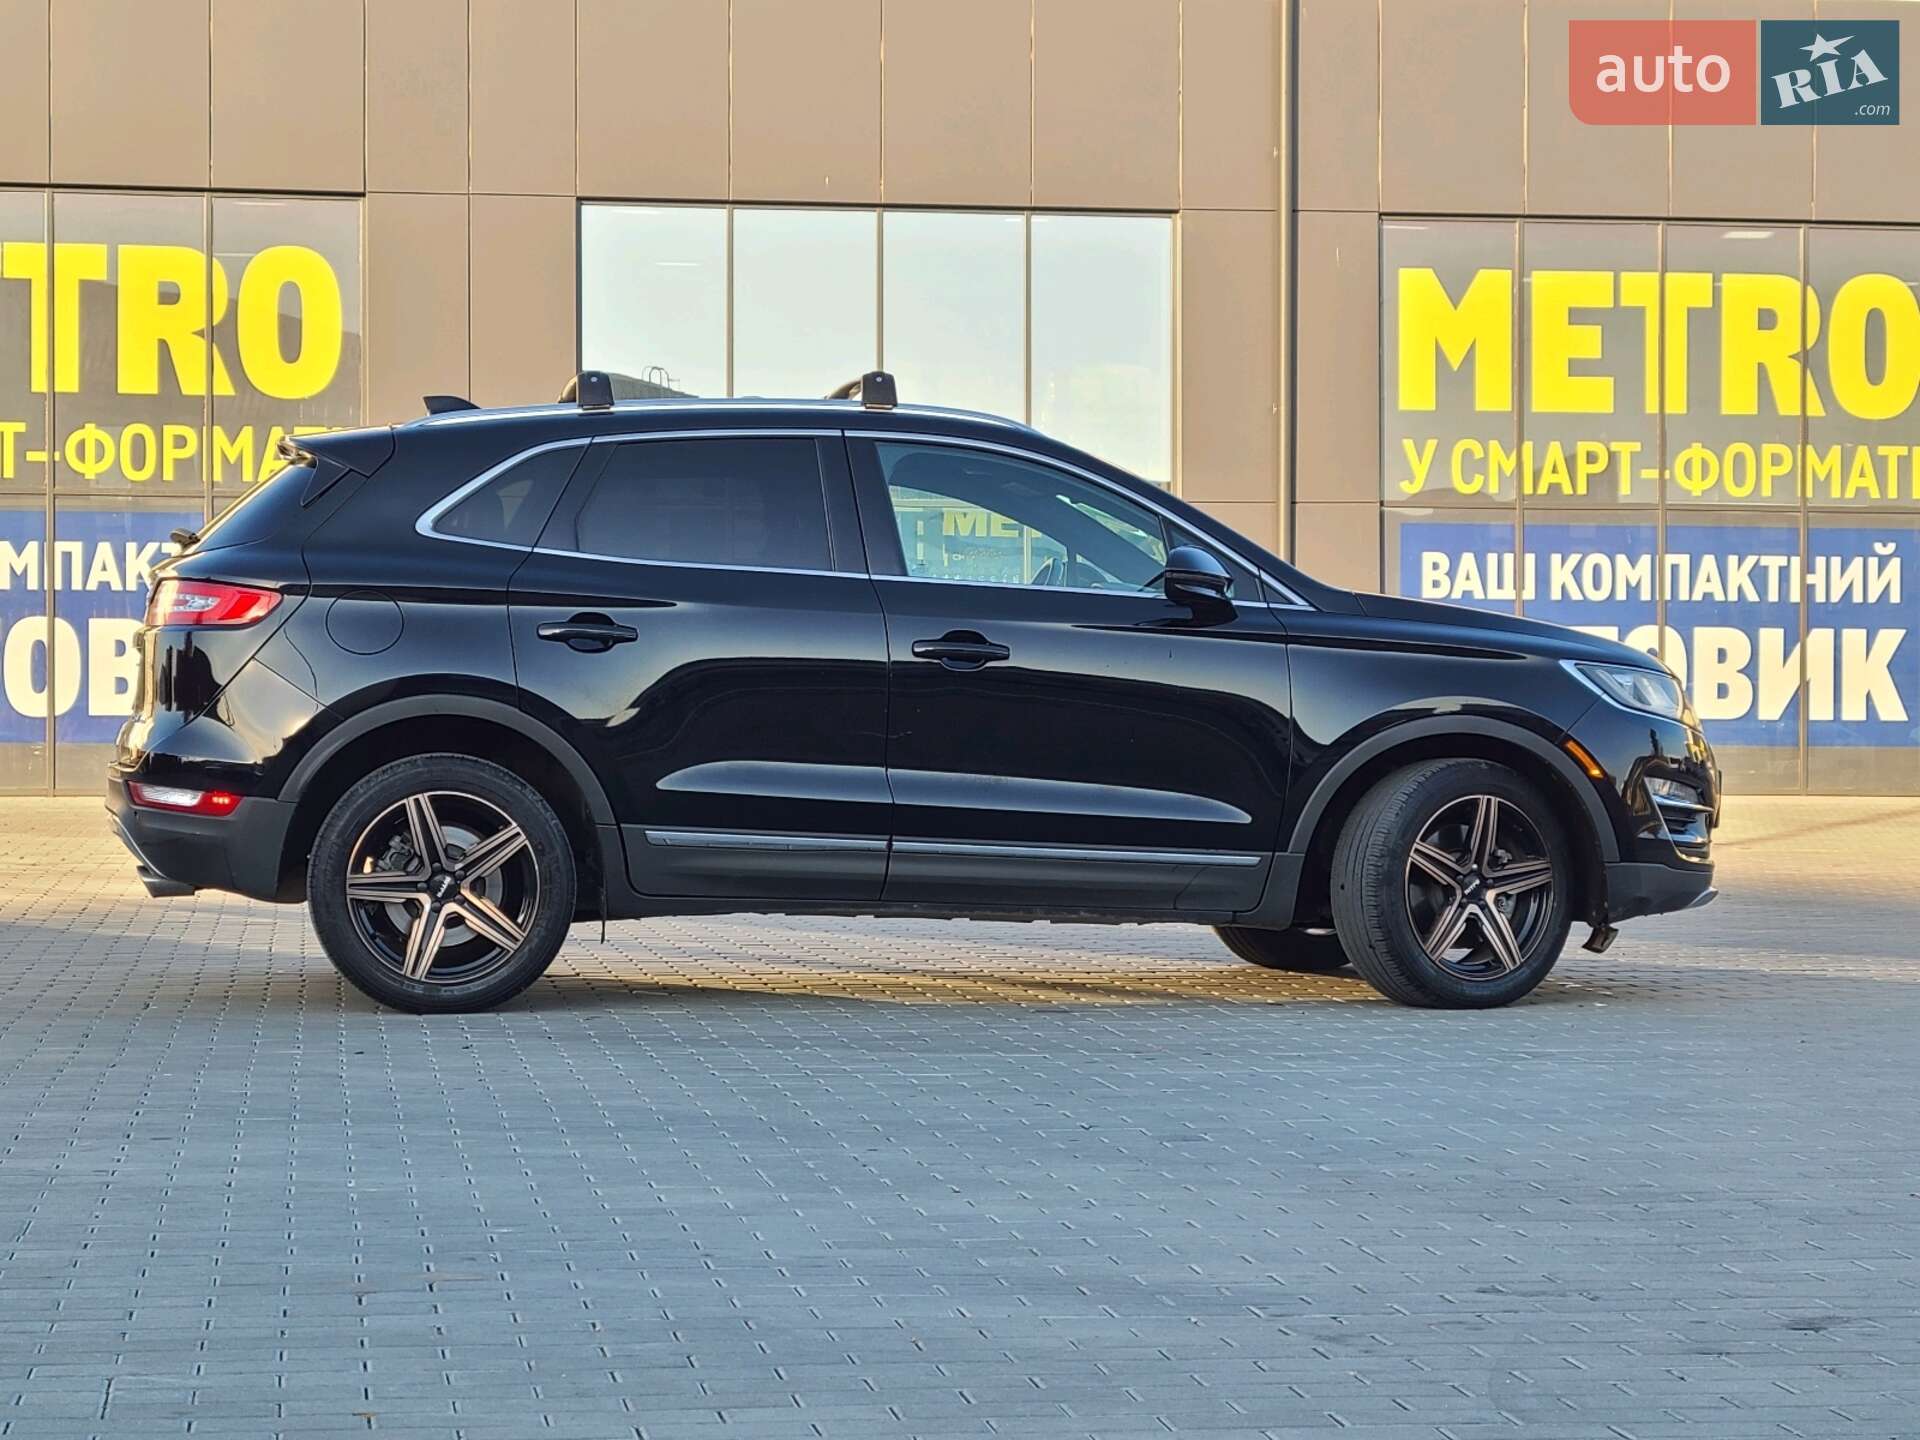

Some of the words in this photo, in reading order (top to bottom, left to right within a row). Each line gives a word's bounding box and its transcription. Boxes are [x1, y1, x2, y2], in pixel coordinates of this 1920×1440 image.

[1399, 267, 1920, 420] METRO
[0, 422, 340, 482] Т-ФОРМА
[1399, 438, 1438, 494] У
[1421, 551, 1535, 600] ВАШ
[1550, 542, 1902, 604] КОМПАКТНИЙ
